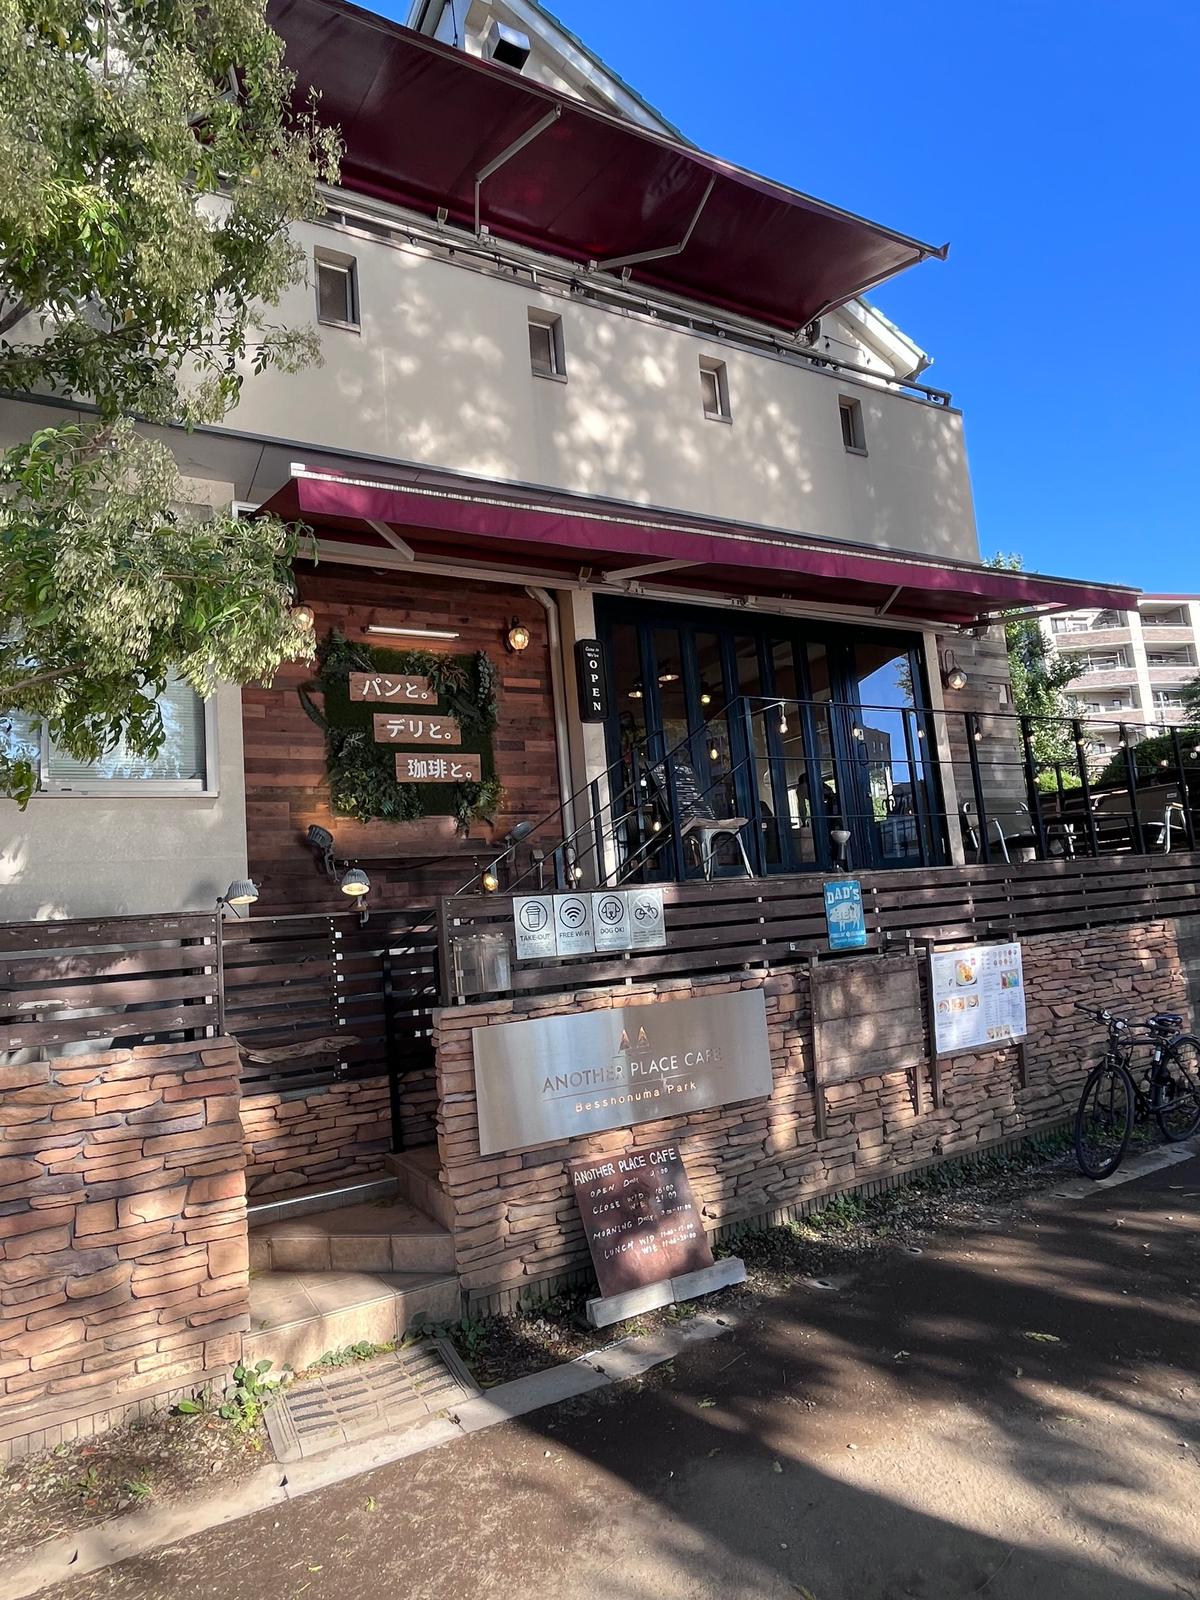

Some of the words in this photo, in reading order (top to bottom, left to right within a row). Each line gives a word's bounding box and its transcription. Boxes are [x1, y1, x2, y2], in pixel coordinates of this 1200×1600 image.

[362, 677, 428, 700] パンと。
[589, 660, 602, 711] OPEN
[386, 719, 452, 740] デリと。
[407, 758, 473, 779] 珈琲と。
[600, 927, 614, 935] DOG
[541, 1065, 625, 1094] ANOTHER
[630, 1055, 679, 1077] PLACE
[684, 1047, 722, 1067] CAFE
[667, 1081, 697, 1095] Park
[574, 1162, 616, 1187] ANOTHER
[618, 1155, 647, 1173] PLACE
[649, 1147, 677, 1165] CAFE
[590, 1183, 615, 1198] OPEN
[592, 1200, 621, 1215] CLOSE
[593, 1220, 633, 1241] MORNING
[604, 1240, 634, 1260] LUNCH
